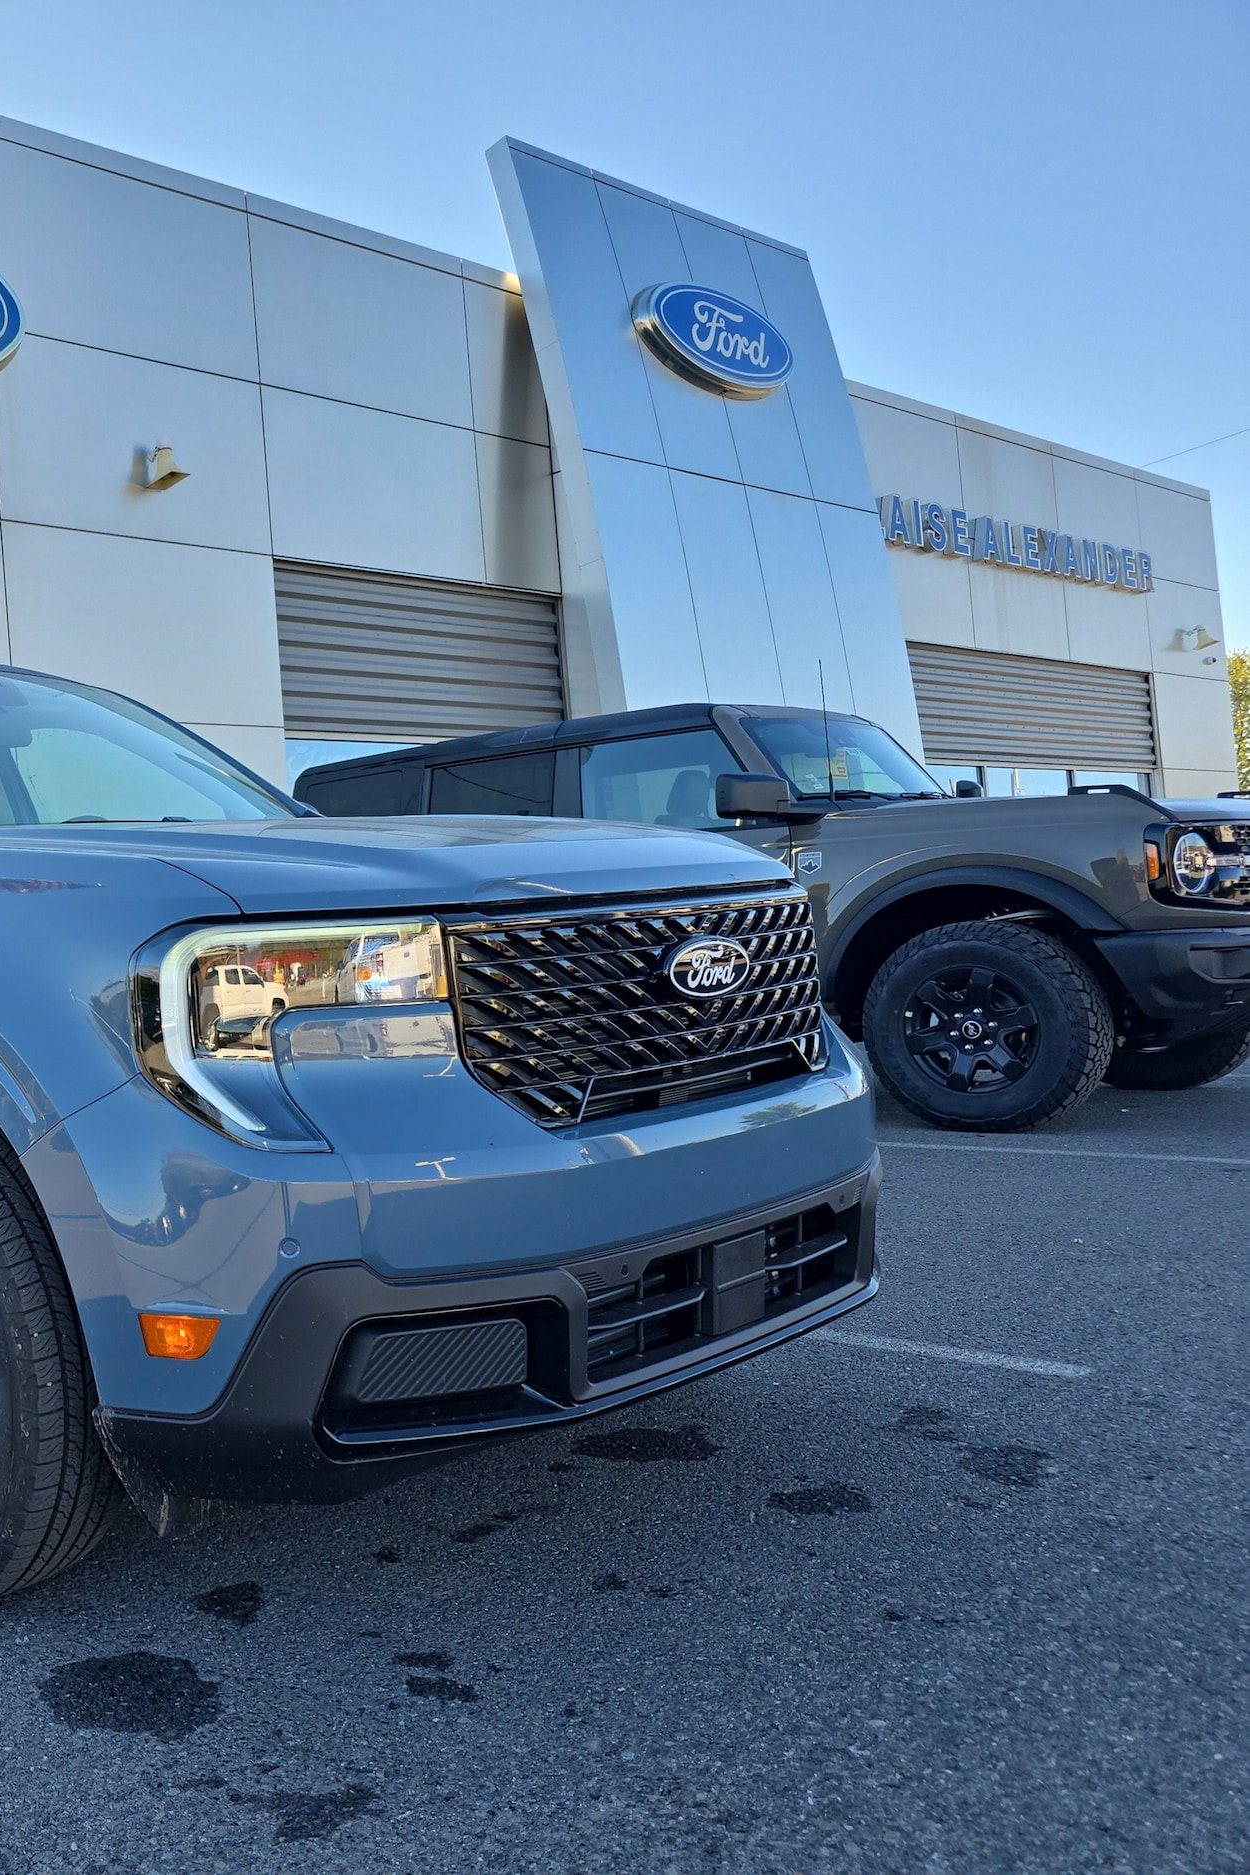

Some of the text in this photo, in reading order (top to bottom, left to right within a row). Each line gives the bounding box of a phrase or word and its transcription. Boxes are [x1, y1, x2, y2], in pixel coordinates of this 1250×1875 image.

[691, 300, 770, 369] Ford
[881, 493, 1155, 592] AISE ALEXANDER
[687, 949, 736, 989] Ford
